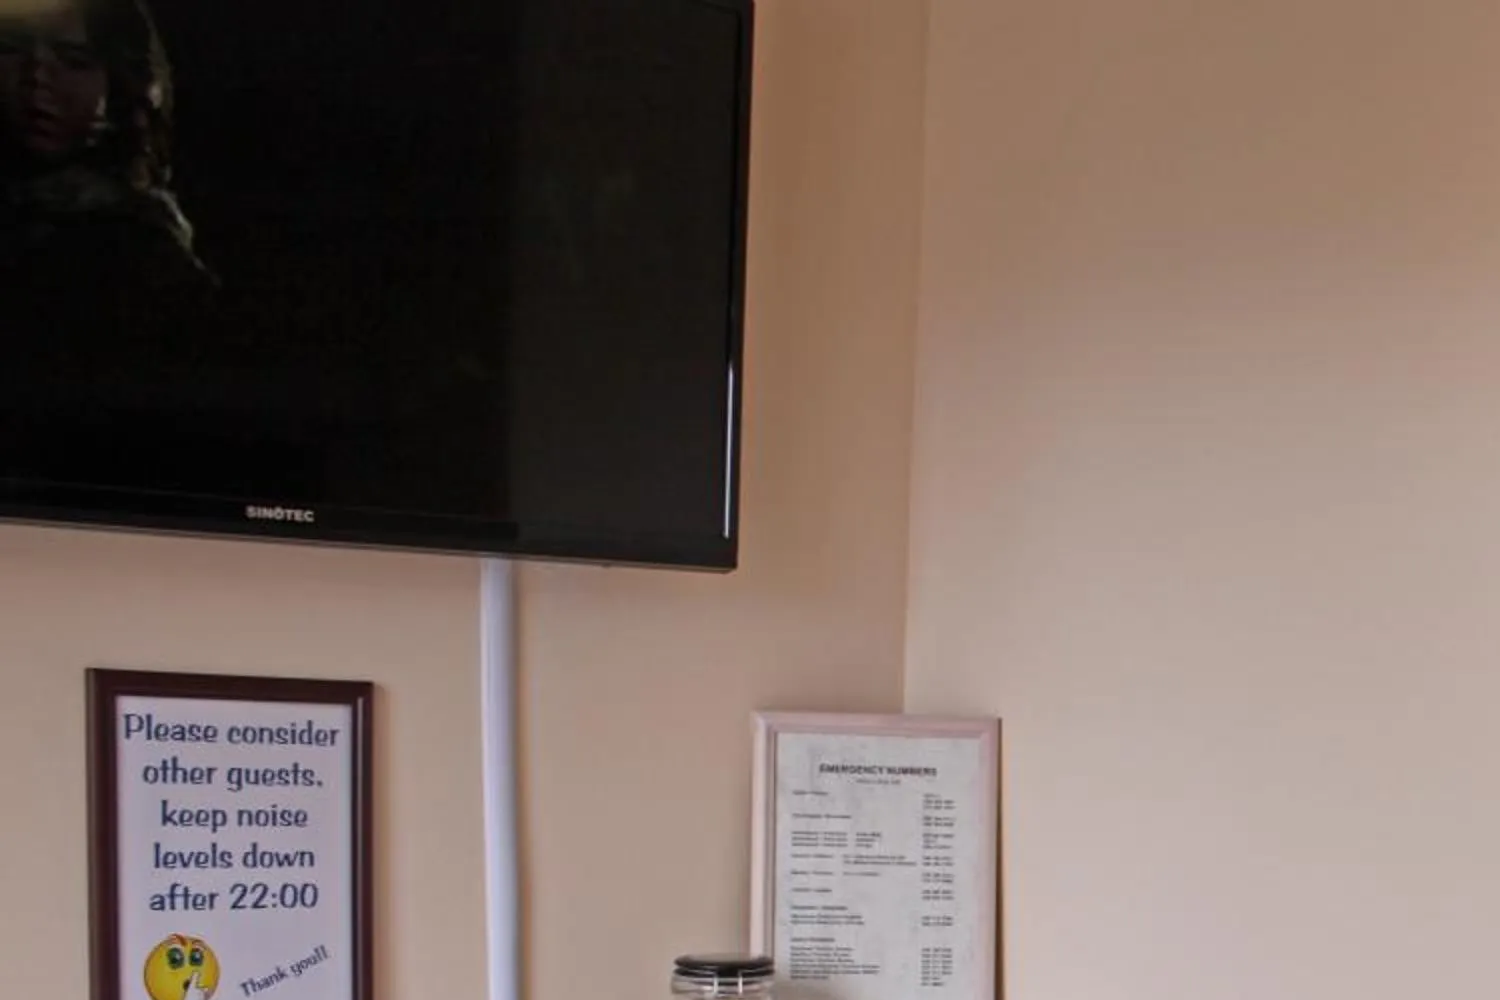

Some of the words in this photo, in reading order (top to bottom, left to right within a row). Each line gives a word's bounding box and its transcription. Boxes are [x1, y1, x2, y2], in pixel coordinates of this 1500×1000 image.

[246, 505, 315, 522] SINOTEC
[124, 713, 219, 742] Please
[227, 720, 340, 746] consider
[142, 756, 218, 785] other
[226, 761, 324, 792] guests.
[819, 763, 884, 775] EMERGENCY
[887, 765, 937, 777] NUMBERS
[161, 800, 227, 831] keep
[237, 804, 308, 827] noise
[154, 842, 234, 869] levels
[242, 842, 315, 868] down
[150, 882, 220, 911] after
[229, 883, 319, 910] 22:00
[240, 966, 288, 997] Thank
